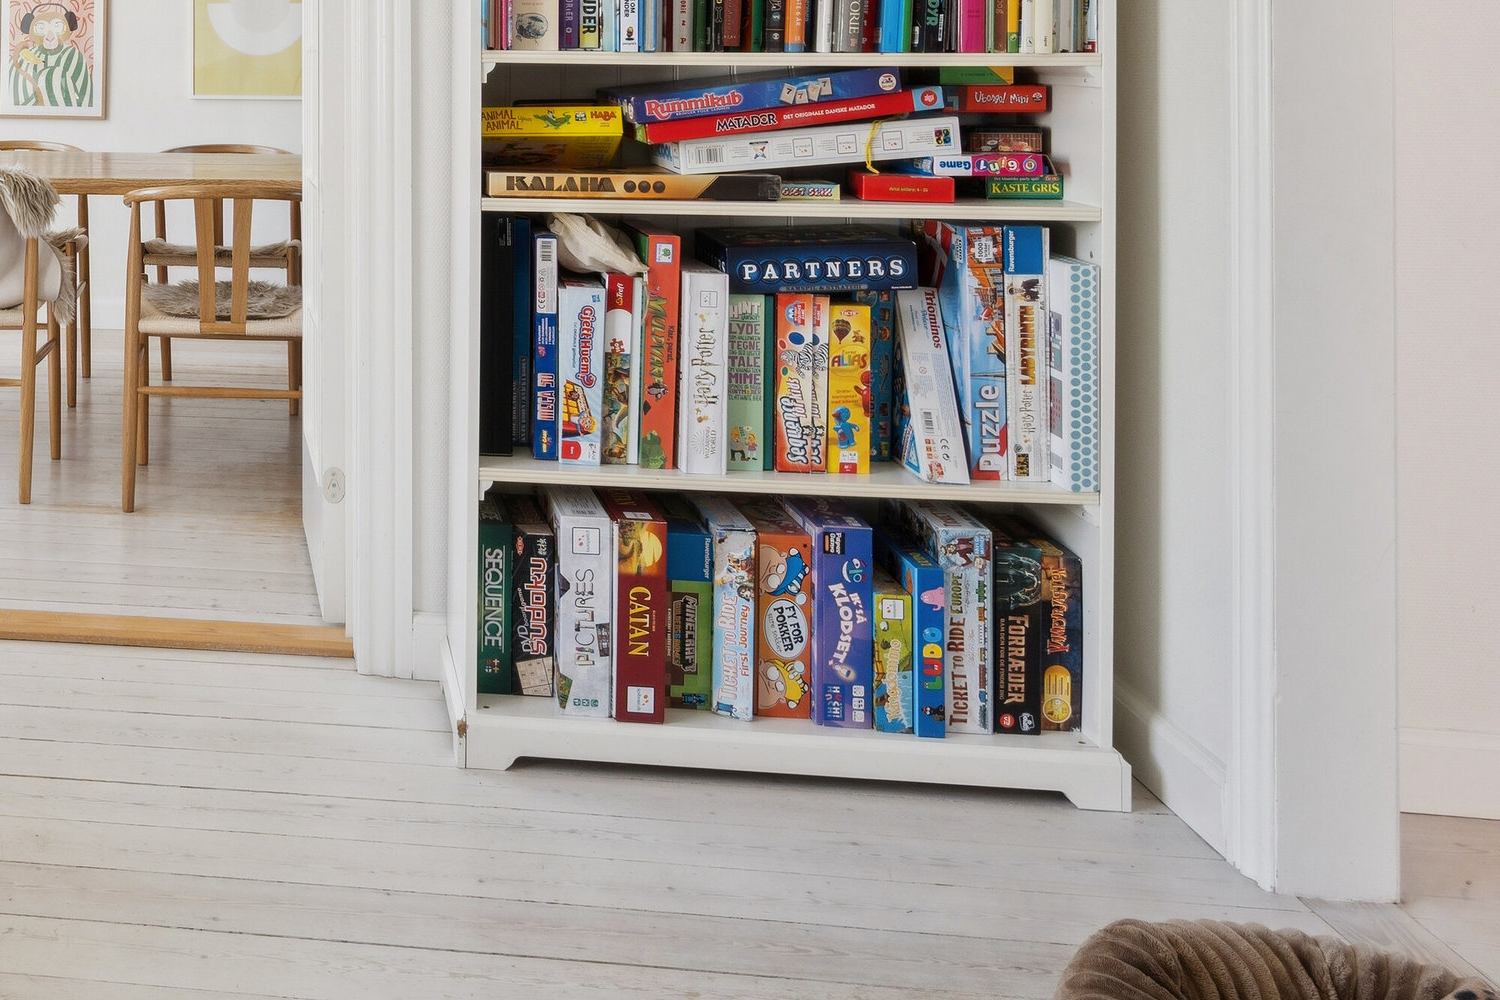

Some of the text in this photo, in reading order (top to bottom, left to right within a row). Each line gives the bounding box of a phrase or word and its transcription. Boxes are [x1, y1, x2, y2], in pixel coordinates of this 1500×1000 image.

[631, 3, 636, 13] OM
[926, 0, 940, 26] DYR
[645, 89, 743, 120] Rummikub
[786, 88, 793, 96] 7
[1009, 93, 1029, 104] Mini
[482, 109, 516, 121] ANIMAL
[486, 120, 523, 131] ANIMAL
[590, 111, 617, 121] HABA
[716, 112, 778, 132] MATADOR
[794, 110, 824, 119] ORIGINALE
[825, 107, 848, 115] DANSKE
[848, 103, 876, 112] MATADOR
[939, 160, 972, 170] Game
[506, 175, 616, 192] KALAHA
[992, 183, 1060, 194] KASTE GRIS
[743, 260, 903, 279] PARTNERS
[578, 306, 596, 338] Gjett
[729, 301, 761, 319] HINT
[924, 291, 942, 349] Triominos
[728, 323, 761, 335] LYDE
[728, 341, 761, 350] TEGNE
[1019, 306, 1036, 387] LABYRINTH
[690, 328, 722, 407] Harry Potter
[728, 356, 761, 367] TALE
[831, 353, 868, 369] ALIAS
[728, 373, 761, 384] MIME
[537, 391, 556, 420] MEGA
[1018, 391, 1035, 413] Potter
[780, 378, 808, 464] Sequence for kids
[974, 386, 1005, 474] Puzzle
[1019, 413, 1036, 435] Harry
[704, 538, 712, 578] Ravensburger
[483, 548, 504, 647] SEQUENCE
[575, 569, 596, 666] PICTURES
[629, 587, 652, 657] CATAN
[773, 606, 794, 652] POKKER
[785, 605, 804, 644] FY FOR
[828, 583, 853, 666] KLODSET!
[517, 625, 531, 652] DVD
[684, 597, 697, 671] MINECRAFT
[717, 592, 738, 700] TICKET TO RIDE
[739, 605, 751, 677] First Journey
[921, 627, 943, 690] LUDO
[946, 573, 969, 726] TICKET TO RIDE EUROPE
[1004, 614, 1029, 704] FORRÆDER
[882, 640, 902, 720] Kingdomino
